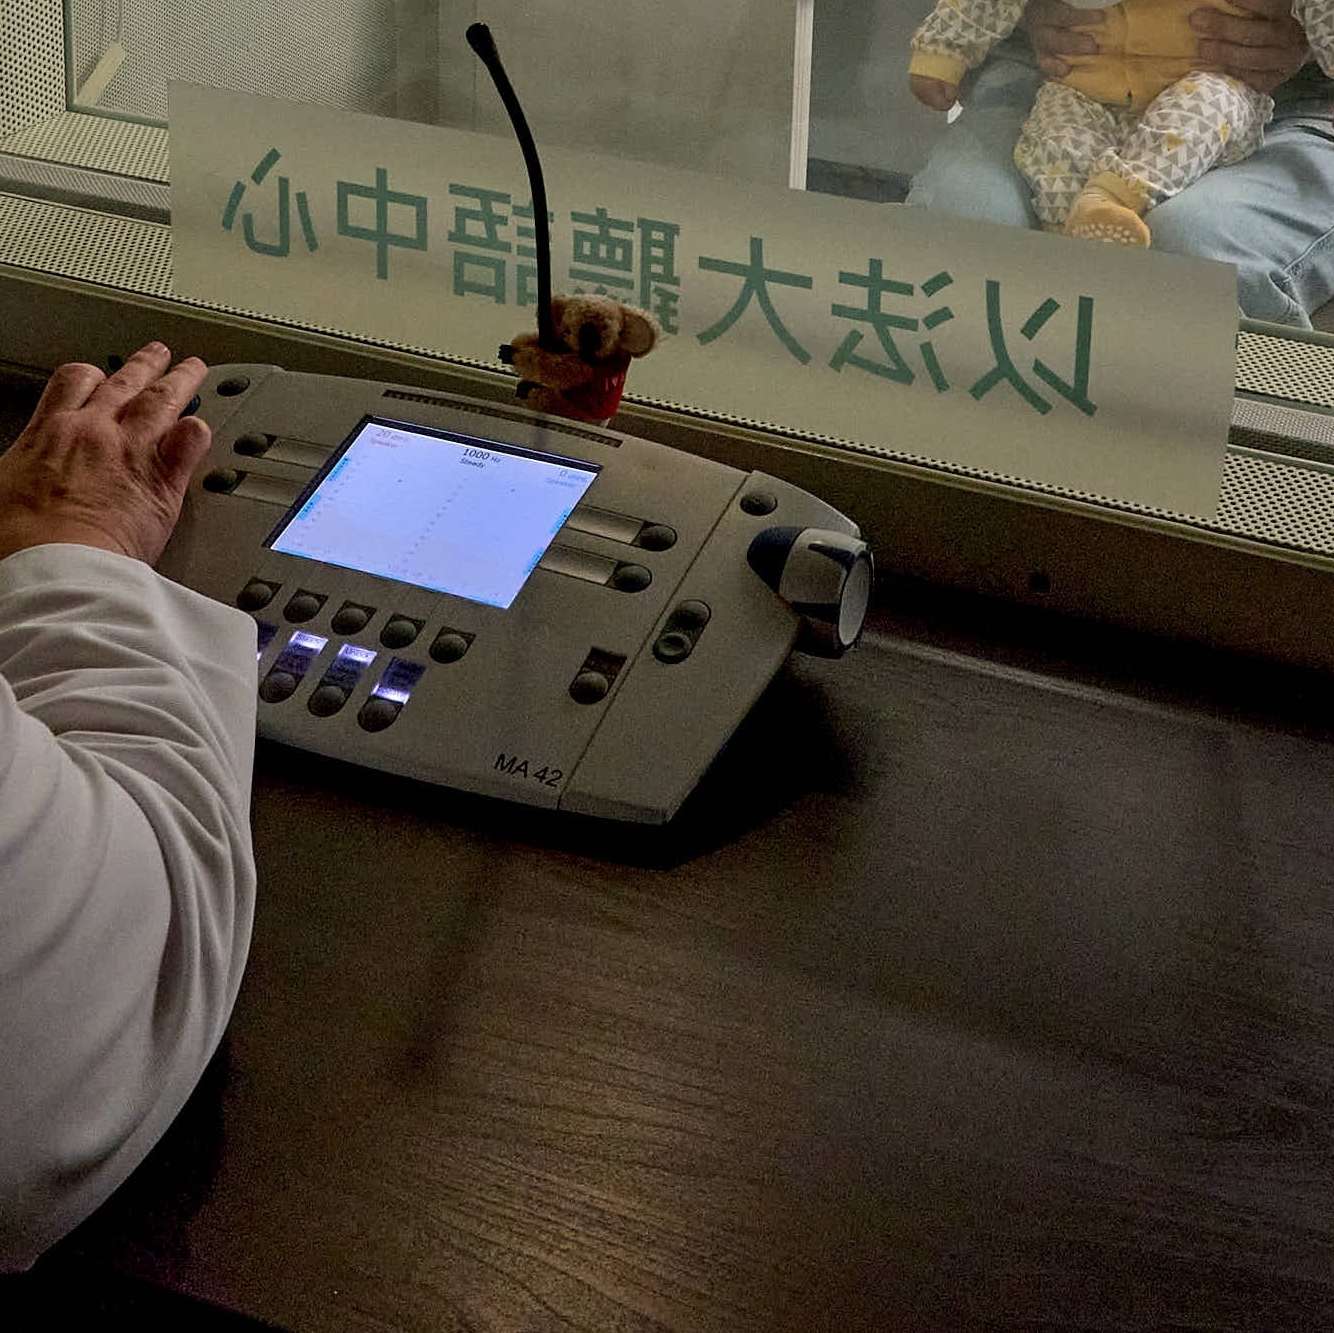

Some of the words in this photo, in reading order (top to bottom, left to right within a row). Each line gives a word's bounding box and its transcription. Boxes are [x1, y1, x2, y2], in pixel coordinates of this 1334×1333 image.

[463, 448, 490, 460] 1000
[459, 457, 486, 469] Steady
[493, 753, 529, 779] MA
[533, 766, 564, 788] 42
